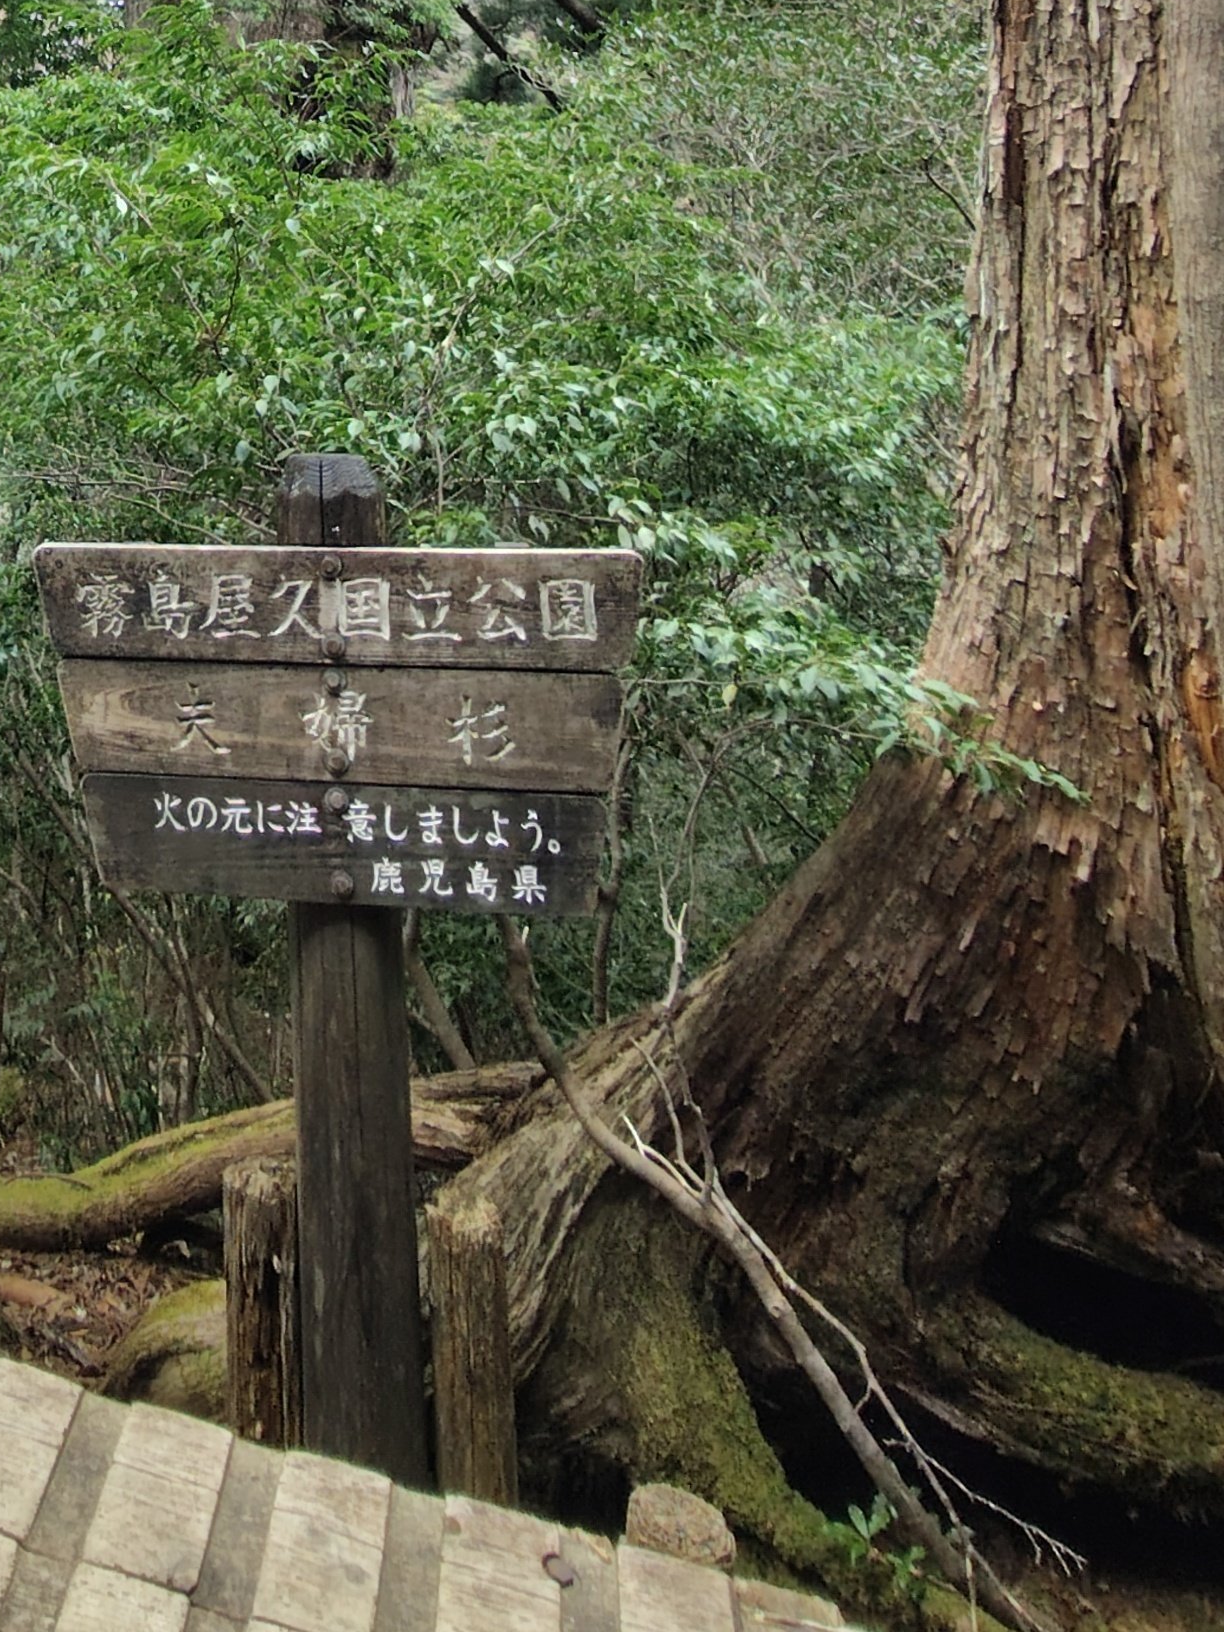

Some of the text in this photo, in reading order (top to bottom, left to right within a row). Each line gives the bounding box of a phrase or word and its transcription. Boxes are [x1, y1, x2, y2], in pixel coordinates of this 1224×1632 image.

[76, 573, 598, 642] 霧島屋久国立公園
[171, 681, 516, 765] 夫婦杉
[371, 857, 547, 904] 鹿児島県
